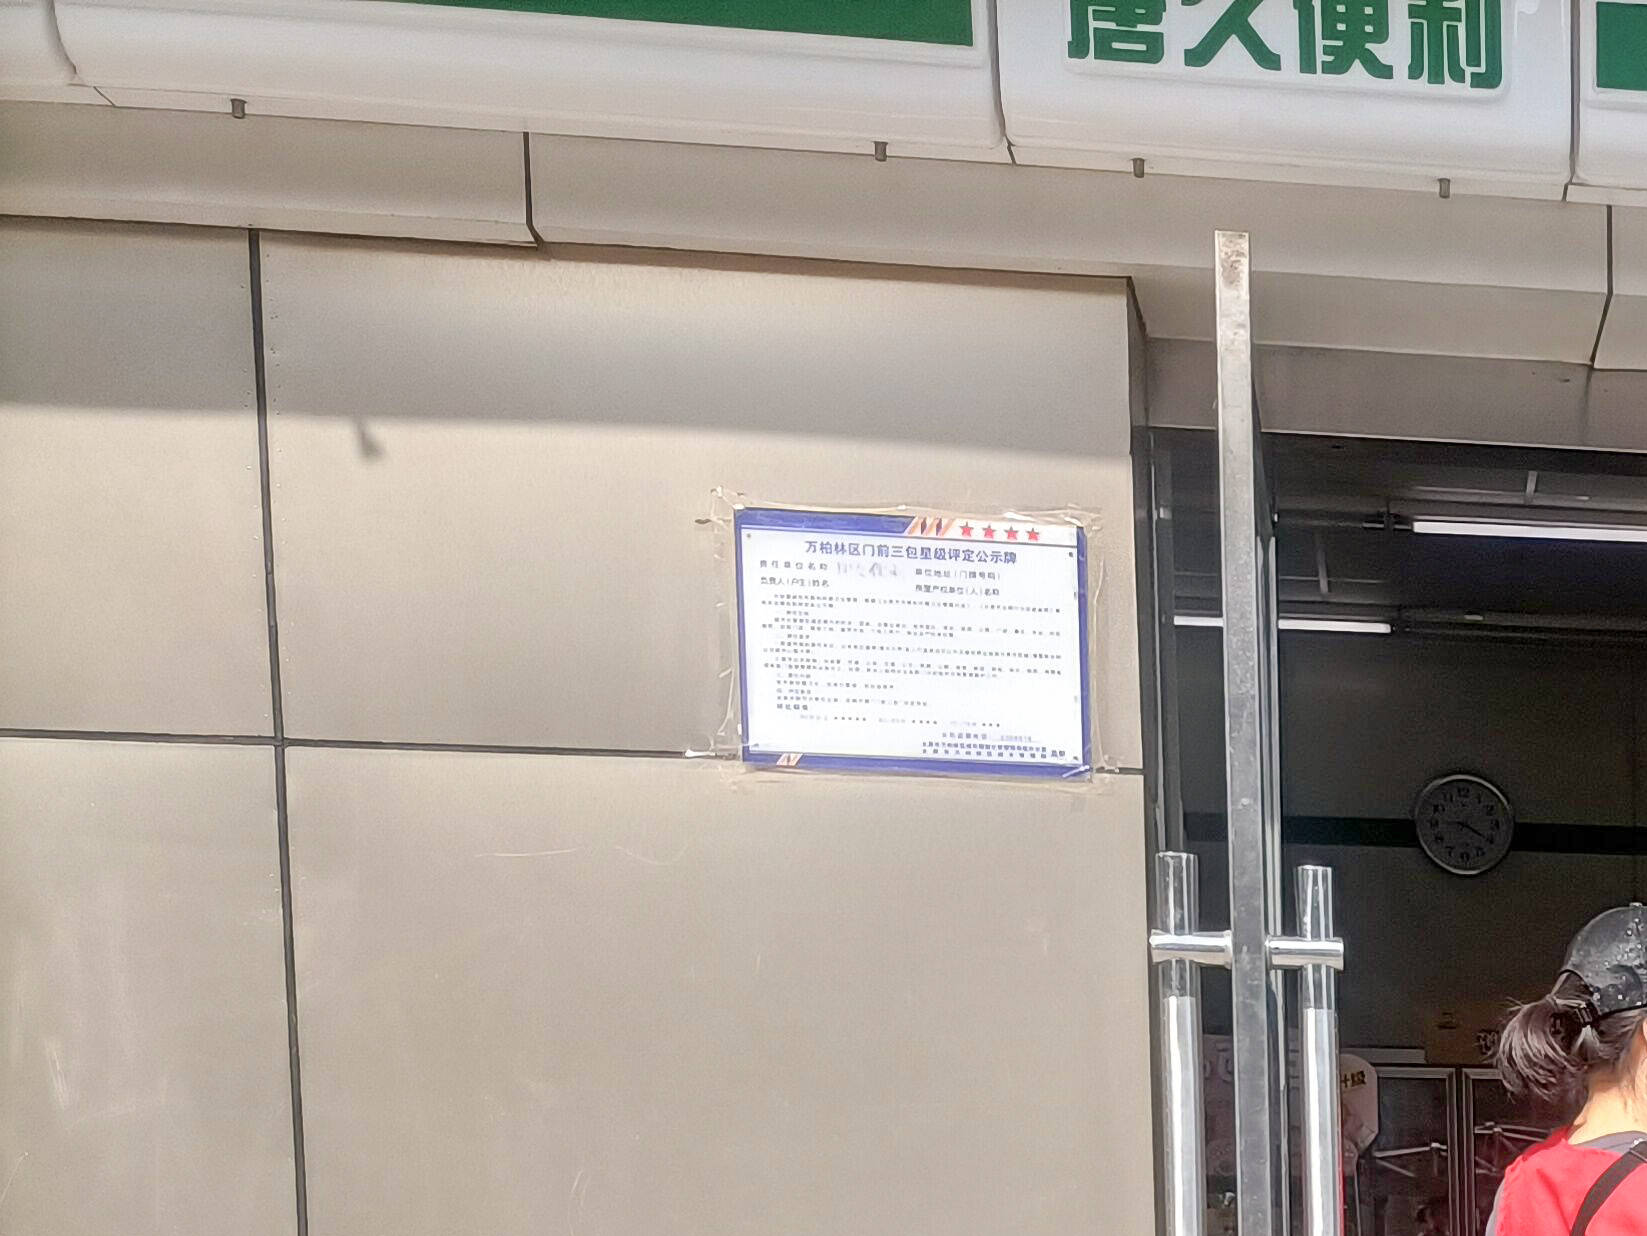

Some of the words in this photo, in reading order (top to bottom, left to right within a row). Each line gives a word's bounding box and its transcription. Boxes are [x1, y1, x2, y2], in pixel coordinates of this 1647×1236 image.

[1068, 0, 1502, 89] 唐久便利
[804, 540, 1017, 565] 万柏林区门前三包星级评定公示牌
